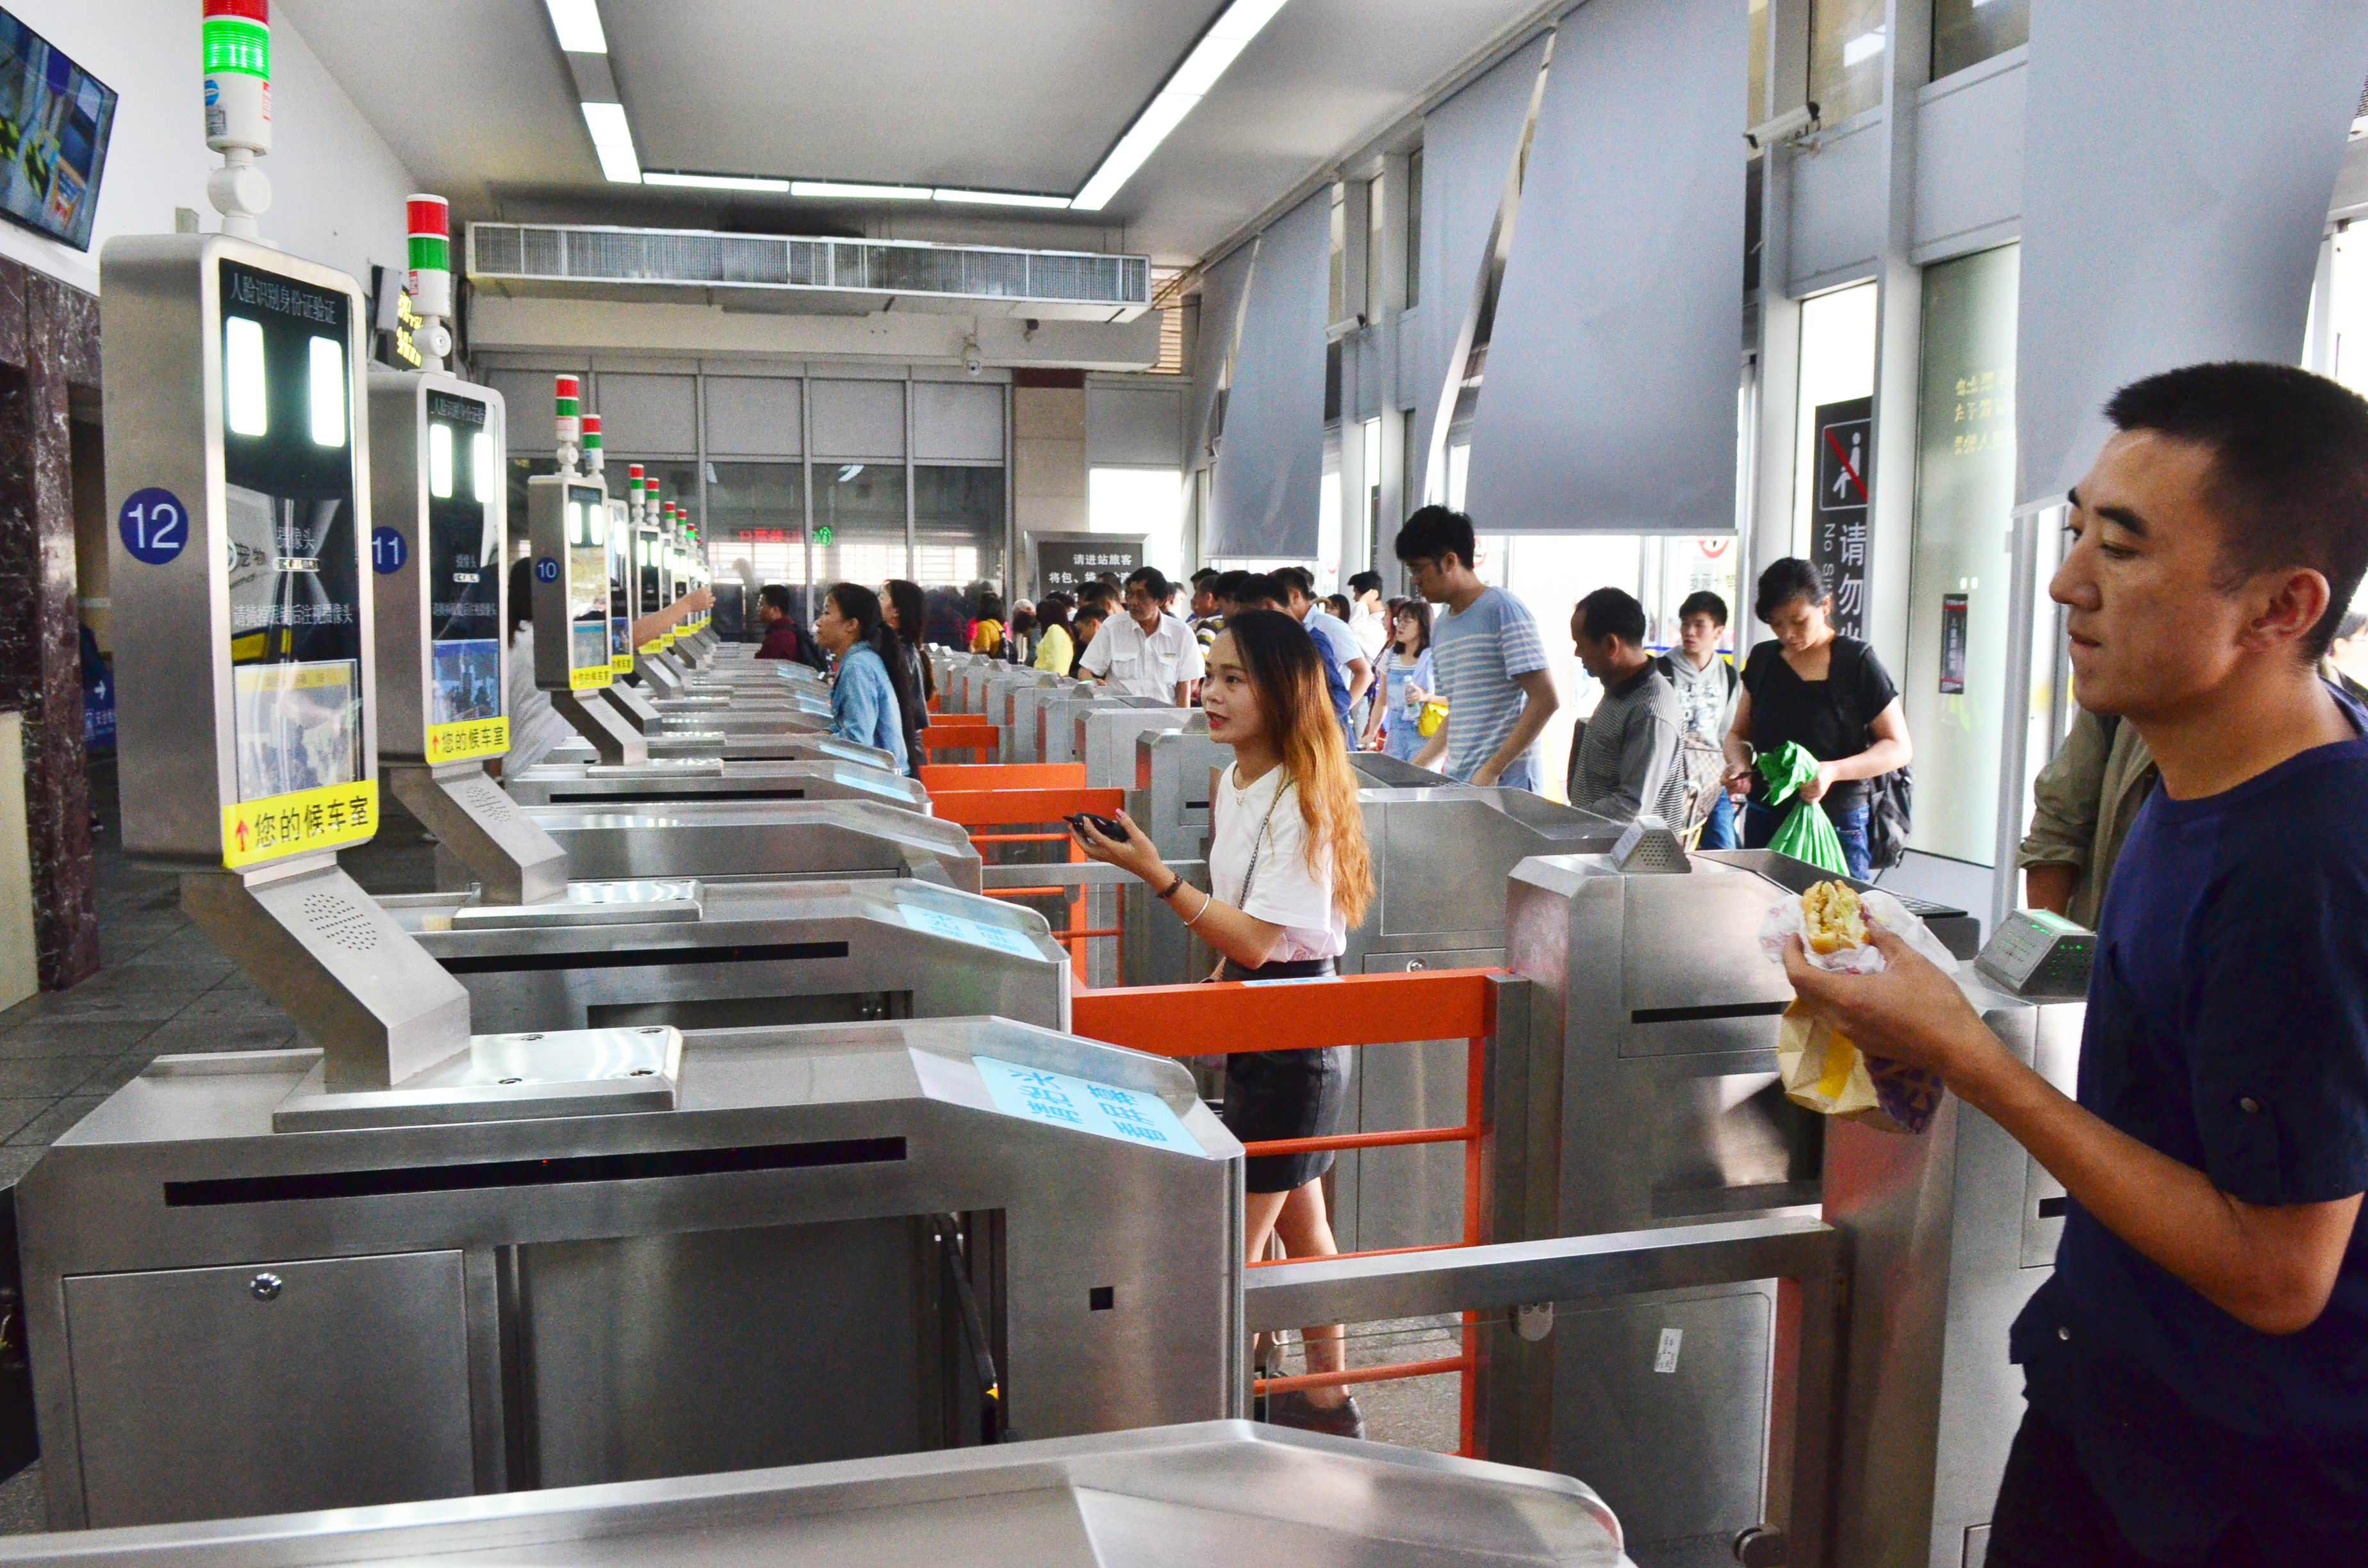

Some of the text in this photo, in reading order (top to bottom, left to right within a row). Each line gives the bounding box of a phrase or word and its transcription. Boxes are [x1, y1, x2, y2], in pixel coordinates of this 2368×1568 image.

[230, 272, 337, 324] 人脸识别身份证验证
[128, 503, 179, 548] 12
[277, 526, 316, 550] 摄像头
[372, 536, 399, 564] 11
[1073, 553, 1132, 566] 请进站旅客
[538, 562, 557, 578] 10
[442, 725, 504, 753] 您的候车室
[255, 795, 369, 848] 您的候车室
